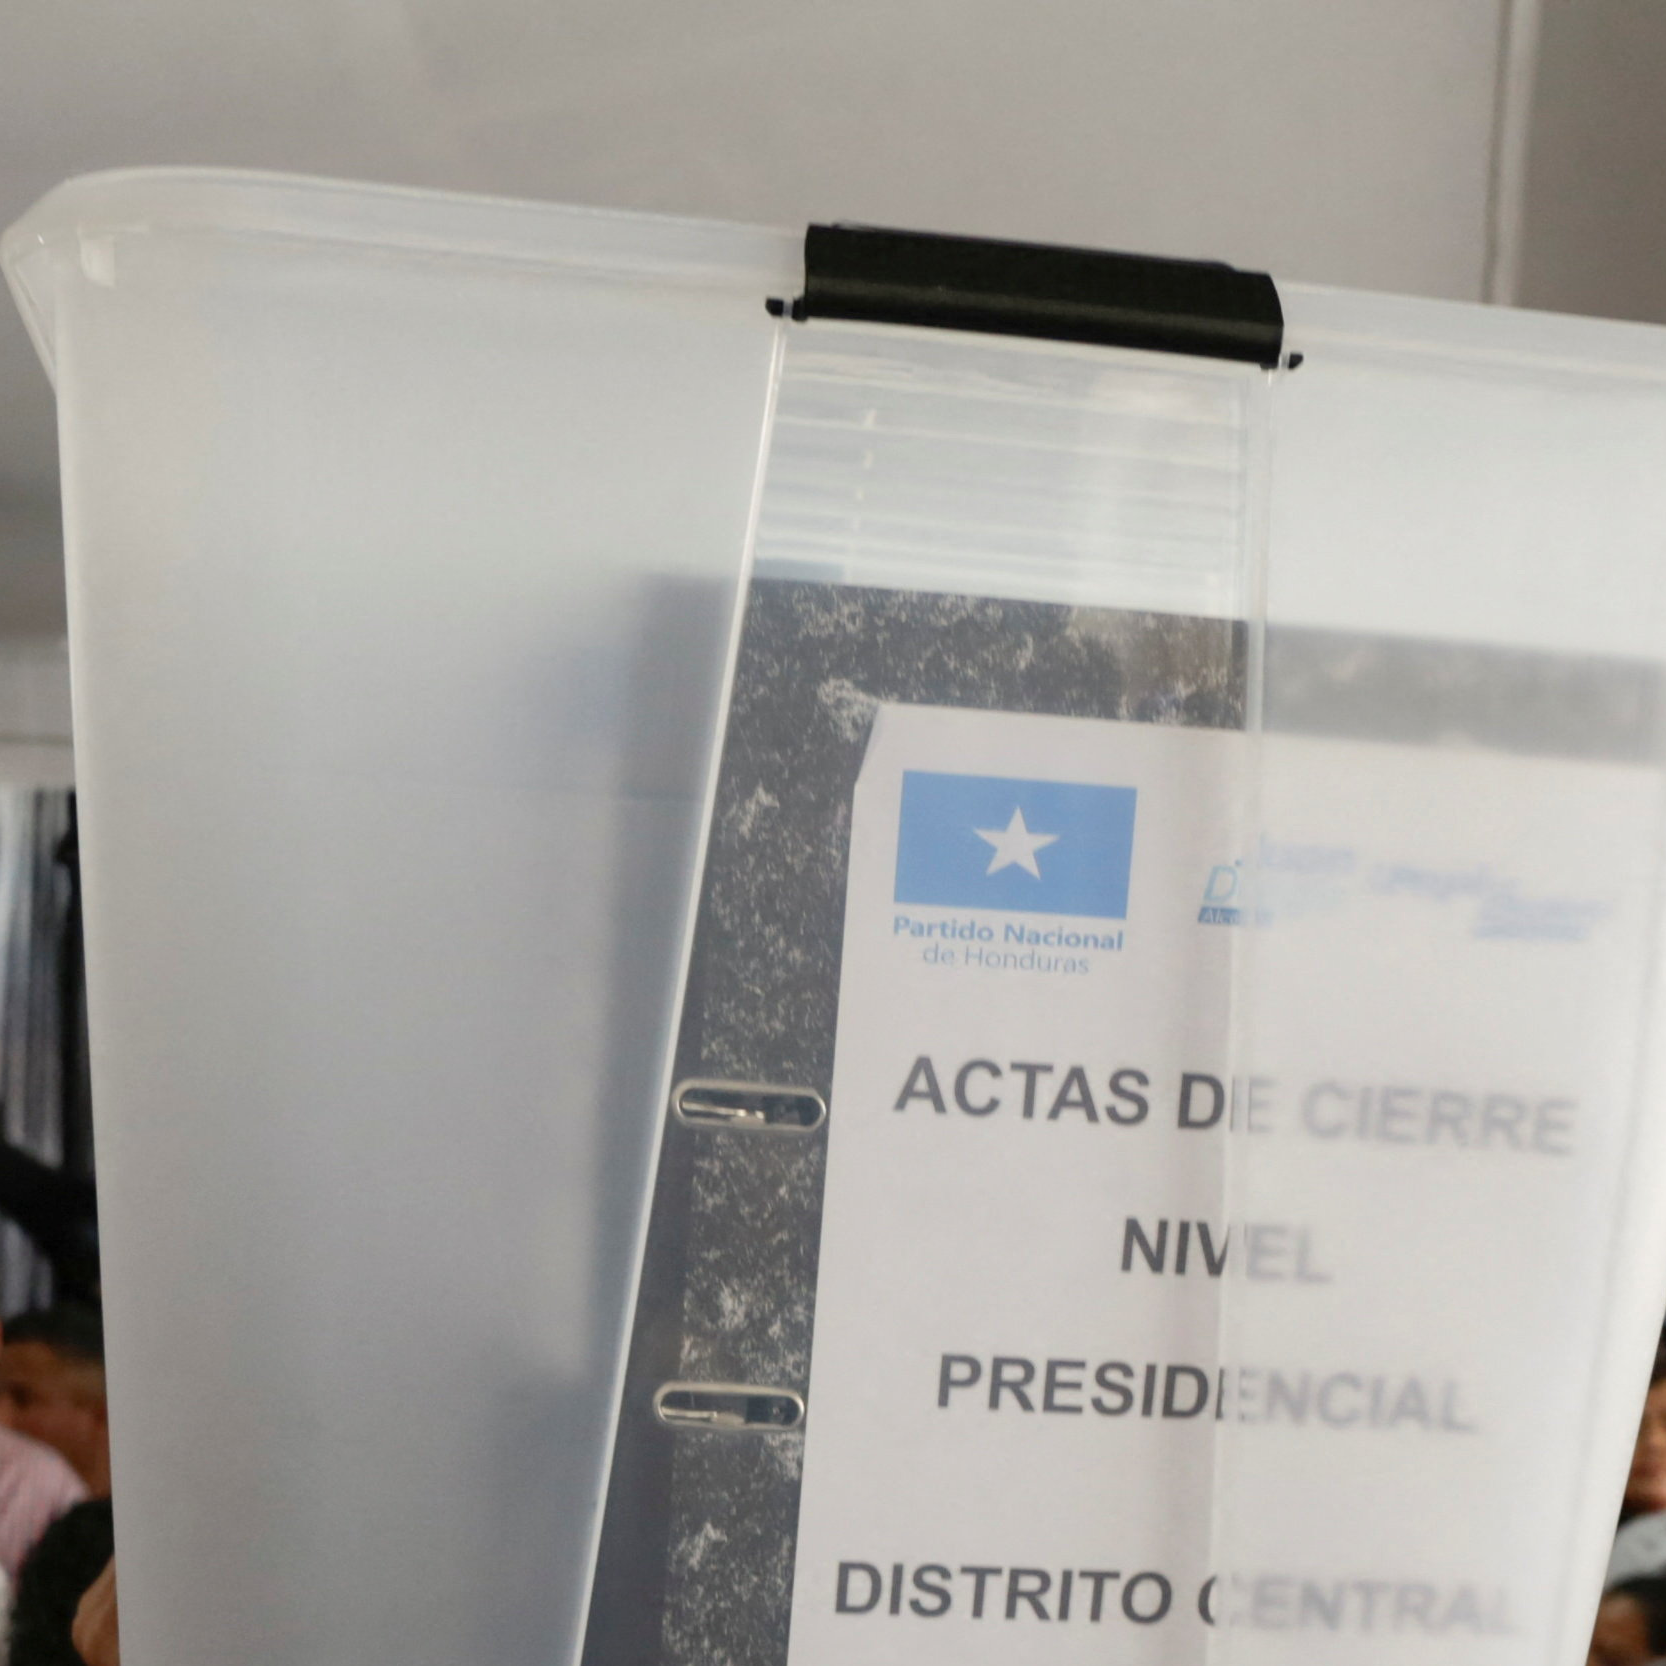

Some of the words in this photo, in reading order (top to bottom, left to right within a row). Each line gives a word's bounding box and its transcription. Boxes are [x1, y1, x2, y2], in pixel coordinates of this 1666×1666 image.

[893, 915, 995, 943] Partido
[1003, 923, 1124, 951] Nacional
[922, 941, 956, 966] de
[964, 944, 1090, 975] Honduras
[892, 1054, 1152, 1128] ACTAS
[1176, 1071, 1275, 1135] DE
[1300, 1078, 1580, 1157] CIERRE
[1120, 1217, 1332, 1285] NIVEL
[935, 1353, 1481, 1435] PRESIDENCIAL
[833, 1560, 1174, 1627] DISTRITO
[1196, 1573, 1523, 1639] CENTRAL
